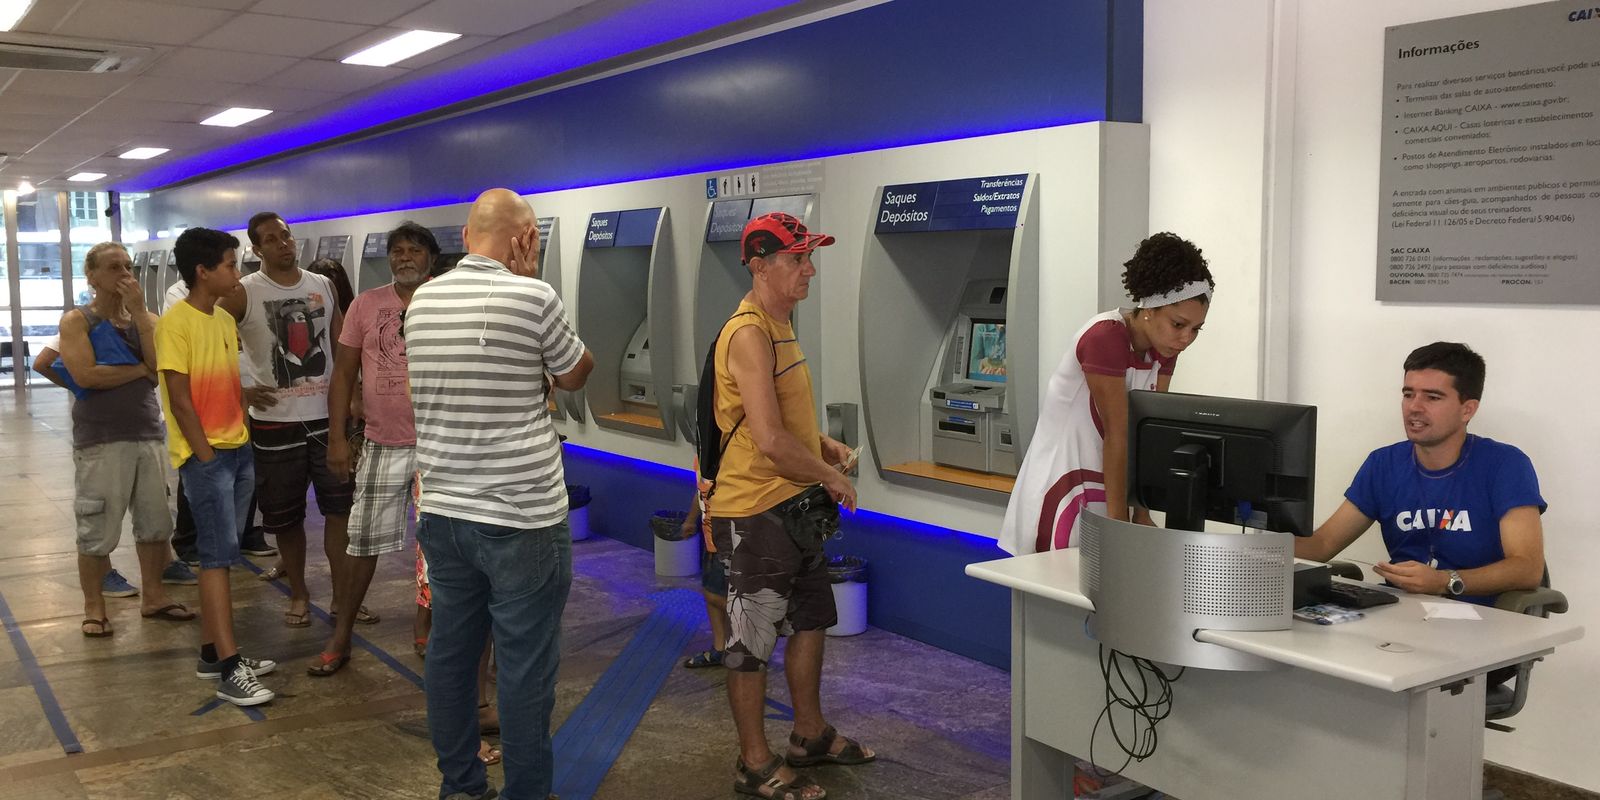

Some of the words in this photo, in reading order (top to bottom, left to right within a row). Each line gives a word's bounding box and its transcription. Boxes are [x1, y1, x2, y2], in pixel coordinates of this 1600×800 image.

[1398, 40, 1480, 59] Informações
[1414, 80, 1440, 89] realizar
[1442, 76, 1473, 86] diversos
[1475, 73, 1506, 81] serviços
[1567, 62, 1588, 71] pode
[1405, 94, 1438, 103] Terminais
[1439, 92, 1452, 100] das
[1454, 89, 1471, 98] salas
[1473, 88, 1483, 96] de
[1403, 110, 1433, 119] Internet
[1434, 107, 1462, 116] Banking
[1464, 102, 1492, 113] CAIXA
[1403, 126, 1429, 135] CAIXA
[1430, 123, 1453, 132] AQUI
[1460, 121, 1482, 130] Casas
[1525, 111, 1594, 124] estabelecimentos
[1404, 136, 1442, 145] comerciais
[1402, 152, 1426, 161] Postos
[1427, 151, 1437, 159] de
[1438, 148, 1486, 158] Atendimento
[1530, 141, 1569, 151] instalados
[1403, 163, 1424, 171] como
[980, 178, 1024, 188] Transferências
[1400, 188, 1427, 197] entrada
[1446, 186, 1473, 194] animais
[1487, 183, 1526, 192] ambientes
[885, 191, 917, 207] Saques
[973, 192, 1020, 202] Saldos/Extratos
[1392, 200, 1423, 208] somente
[1425, 199, 1441, 207] para
[1480, 193, 1538, 204] acompanhados
[1541, 192, 1552, 200] de
[1554, 192, 1586, 201] pessoas
[980, 204, 1017, 215] Pagamentos
[1391, 209, 1428, 218] deficiência
[1429, 208, 1449, 216] visual
[1460, 207, 1469, 215] de
[1488, 205, 1532, 213] treinadores
[591, 217, 608, 229] Saques
[880, 209, 928, 226] Depósitos
[1391, 219, 1405, 230] (Lei
[1405, 219, 1432, 228] Federal
[1475, 216, 1507, 225] Decreto
[1508, 215, 1537, 224] Federal
[588, 230, 613, 242] Depósitos
